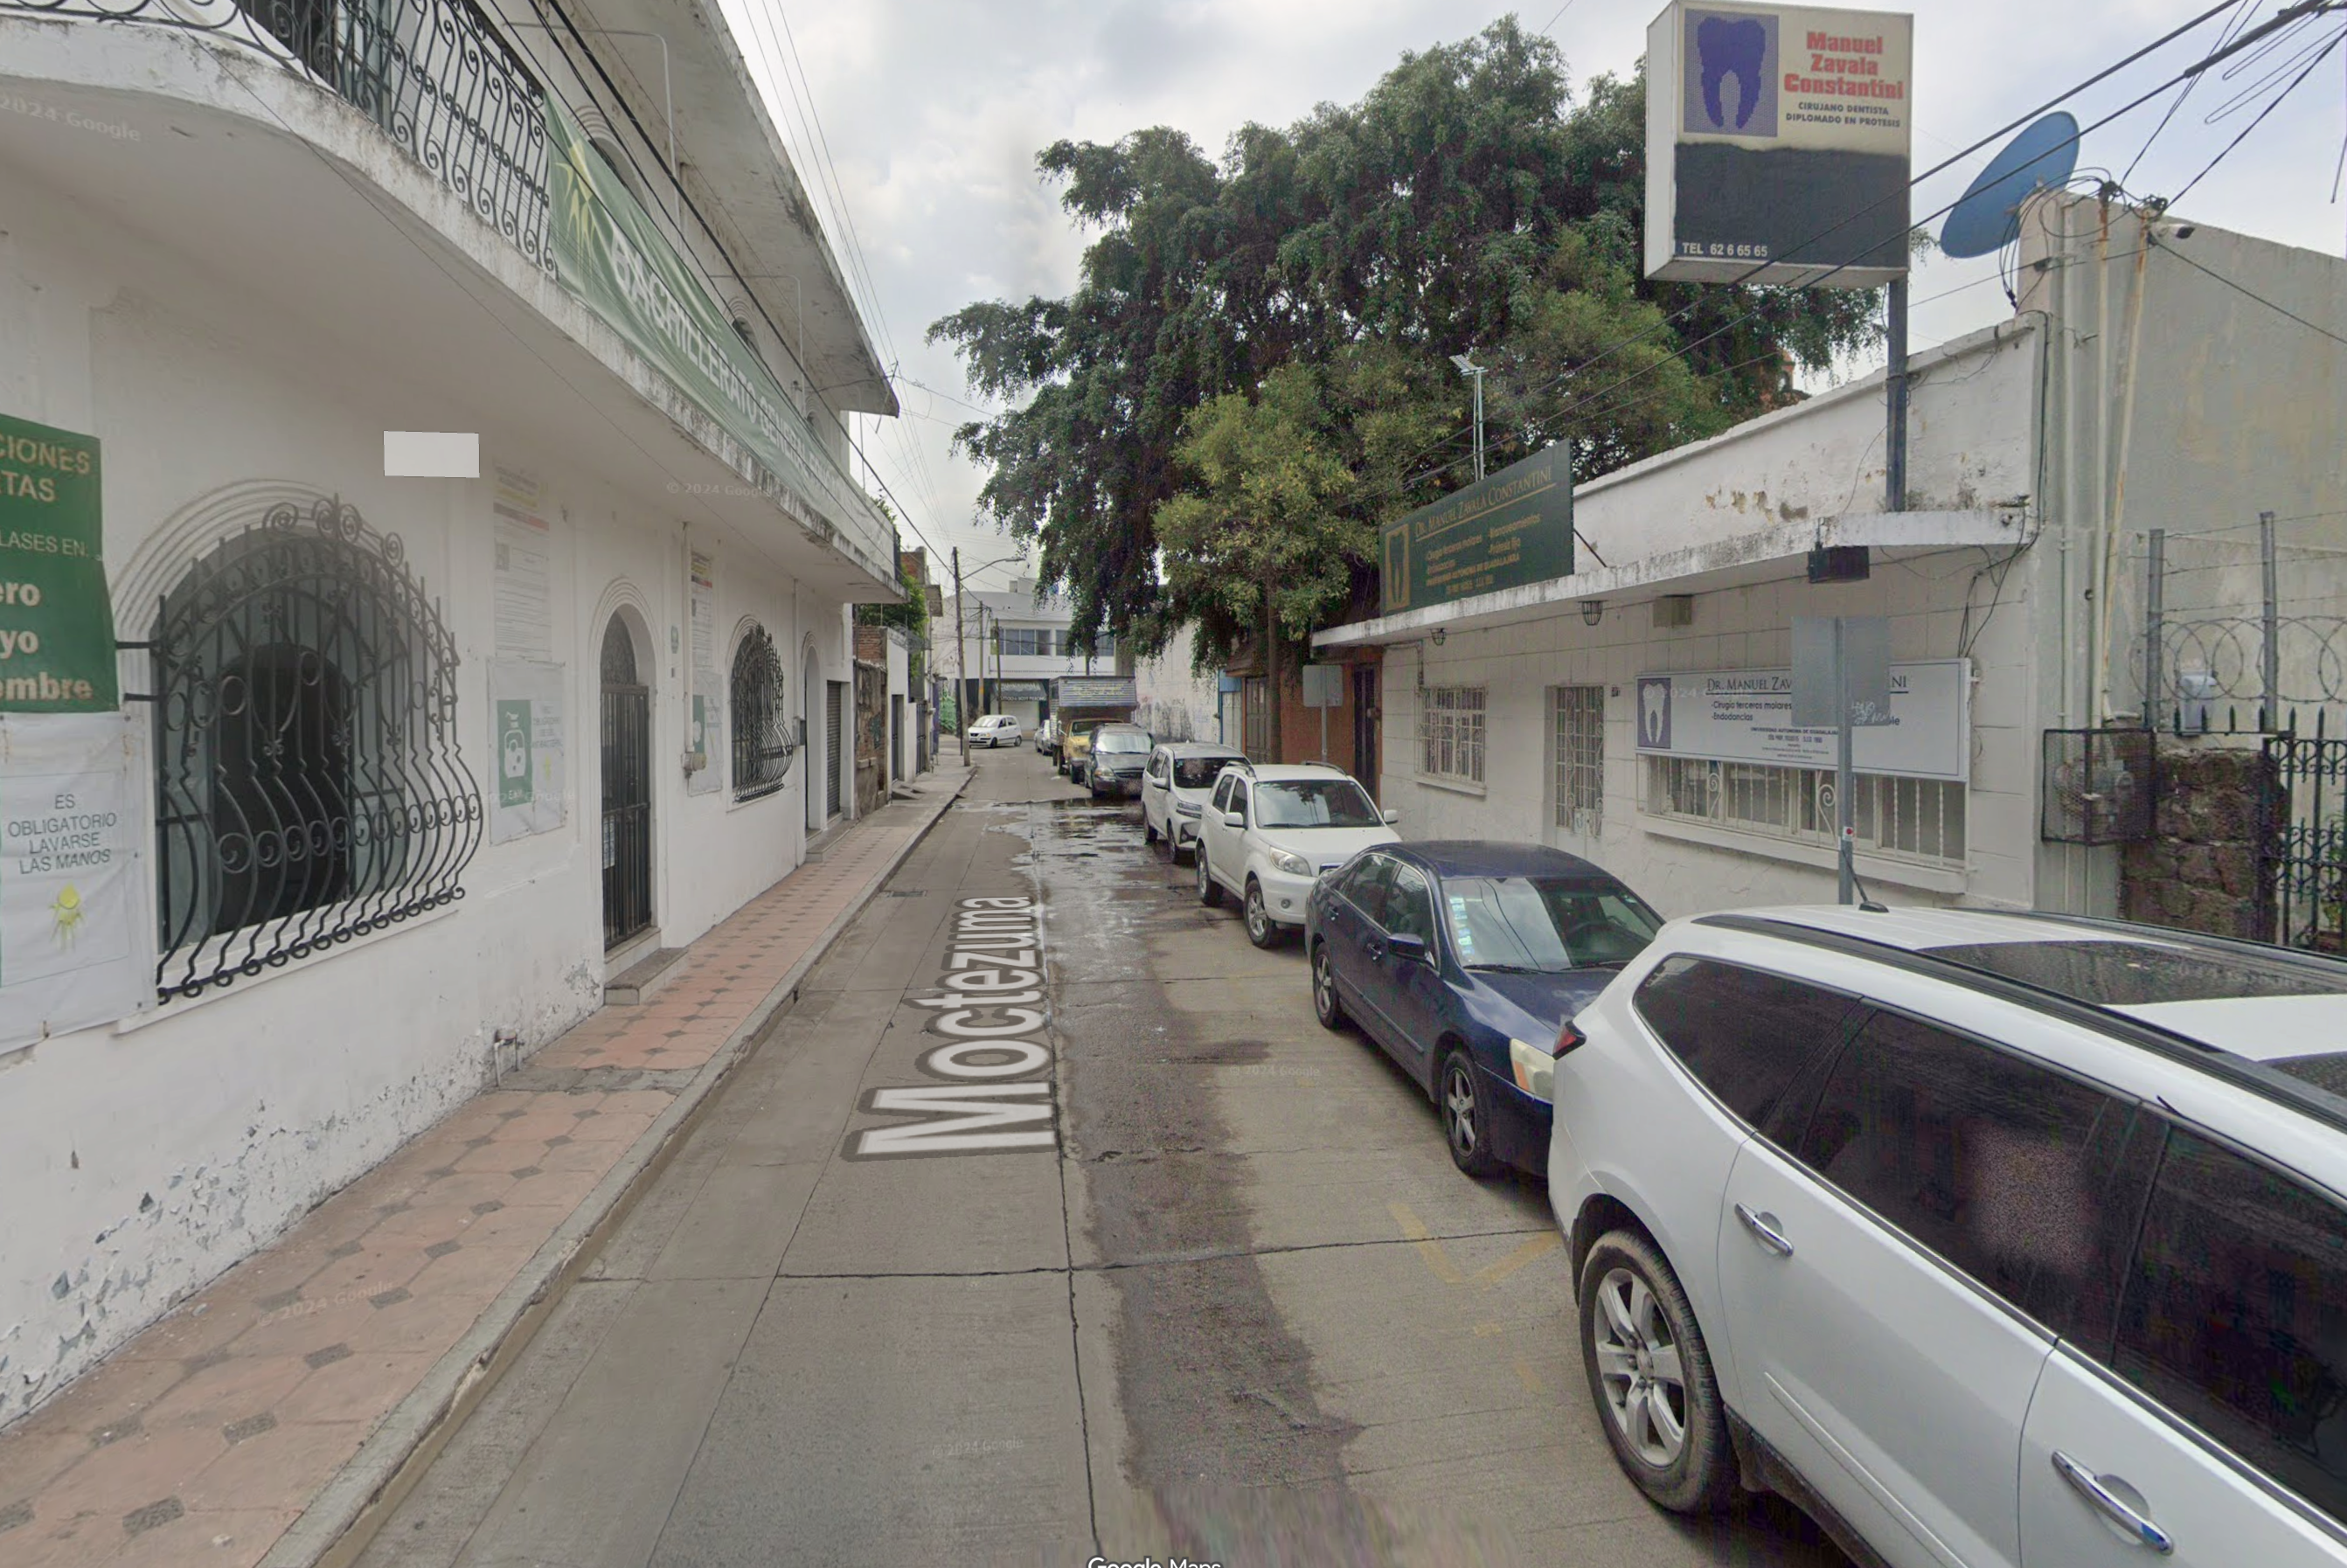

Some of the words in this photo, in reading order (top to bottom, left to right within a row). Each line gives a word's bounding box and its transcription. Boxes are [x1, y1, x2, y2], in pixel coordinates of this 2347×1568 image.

[1807, 31, 1883, 54] Manuel
[1810, 53, 1878, 75] Zavala
[1784, 73, 1904, 99] Constantini
[1798, 101, 1844, 112] CIRUJANO
[1847, 104, 1889, 114] DENTISTA
[1786, 113, 1841, 124] DIPLOMADO
[1844, 116, 1857, 125] EN
[1859, 117, 1900, 128] PROTESIS
[1682, 242, 1704, 254] TEL
[1711, 244, 1724, 255] 62
[1726, 244, 1734, 256] 6
[1737, 245, 1751, 257] 65
[1753, 246, 1767, 257] 65
[612, 231, 757, 424] BACHILLERATO
[760, 396, 809, 479] GENERAL
[0, 470, 55, 502] TAS
[1488, 465, 1552, 506] CONSTANTINI
[0, 581, 40, 607] ro
[0, 670, 93, 701] mbre
[1727, 677, 1768, 690] MANUEL
[1771, 676, 1792, 690] ZAV
[54, 794, 76, 809] ES
[8, 812, 117, 838] OBLIGATORIO
[29, 831, 101, 854] LAVARSE
[19, 856, 52, 874] LAS
[56, 848, 112, 870] MANOS
